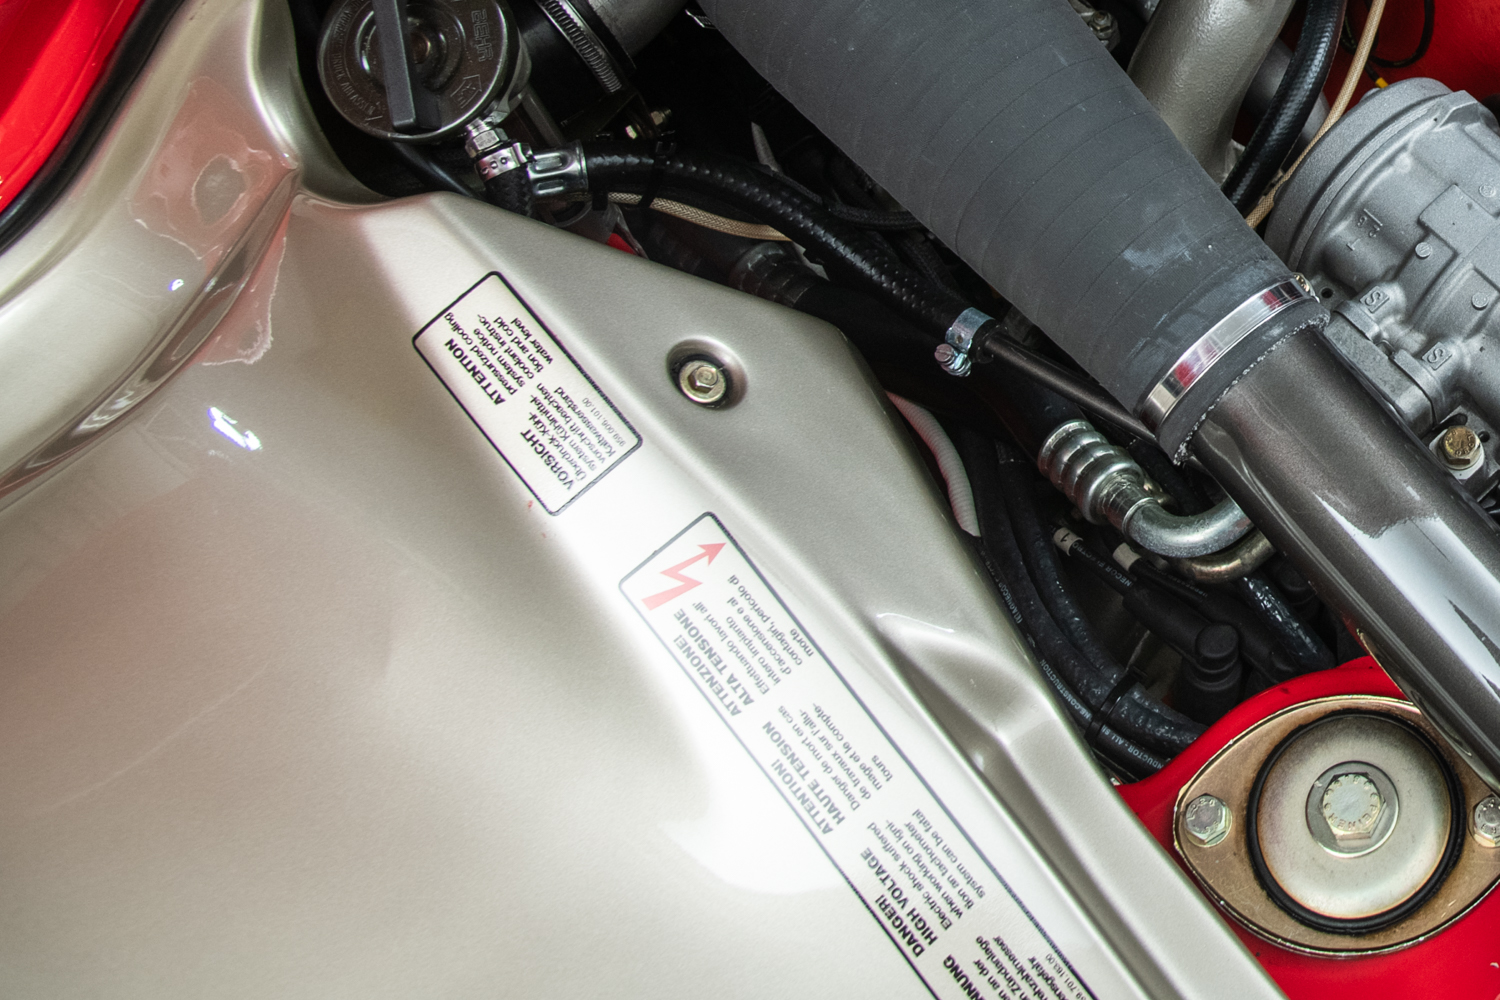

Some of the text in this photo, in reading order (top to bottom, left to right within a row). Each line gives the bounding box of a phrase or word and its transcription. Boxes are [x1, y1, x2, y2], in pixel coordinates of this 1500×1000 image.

[441, 310, 517, 396] pressurized cooling
[444, 337, 505, 407] ATTENTION
[471, 327, 526, 388] system notice
[474, 311, 535, 380] coolant instruc-
[493, 315, 544, 373] tion and cold
[510, 316, 553, 365] water level
[519, 426, 576, 490] VORSICHT
[527, 392, 598, 472] system Kühlmittel-
[534, 381, 607, 465] vorschrift beachten
[553, 385, 616, 457] Kaltwasserstand
[672, 607, 754, 707] ALTA TENSIONE
[691, 598, 770, 695] Effettuando lavori all'
[723, 613, 781, 685] intero impianto
[726, 574, 805, 667] contagiri, pericolo di
[726, 596, 792, 677] d'accensione e al
[787, 626, 815, 658] morte
[672, 633, 742, 718] ATTENZIONE!
[761, 720, 846, 824] HAUTE TENSION
[775, 704, 862, 810] Danger de mort en cas
[795, 706, 872, 801] de travaux sur l'allu-
[809, 699, 884, 791] mage et le compte-
[869, 753, 894, 782] tours
[769, 758, 834, 836] ATTENTION!
[865, 821, 953, 930] Electric shock suffered
[881, 816, 964, 920] when working on igni-
[901, 819, 975, 909] tion an tachometer
[910, 807, 988, 900] system can be fatal
[859, 846, 938, 945] HIGH VOLTAGE
[872, 893, 926, 957] DANGER!
[971, 957, 990, 978] der
[972, 933, 1024, 994] Zündanlage
[985, 975, 1001, 991] an
[1026, 953, 1068, 1000] ensgefahr
